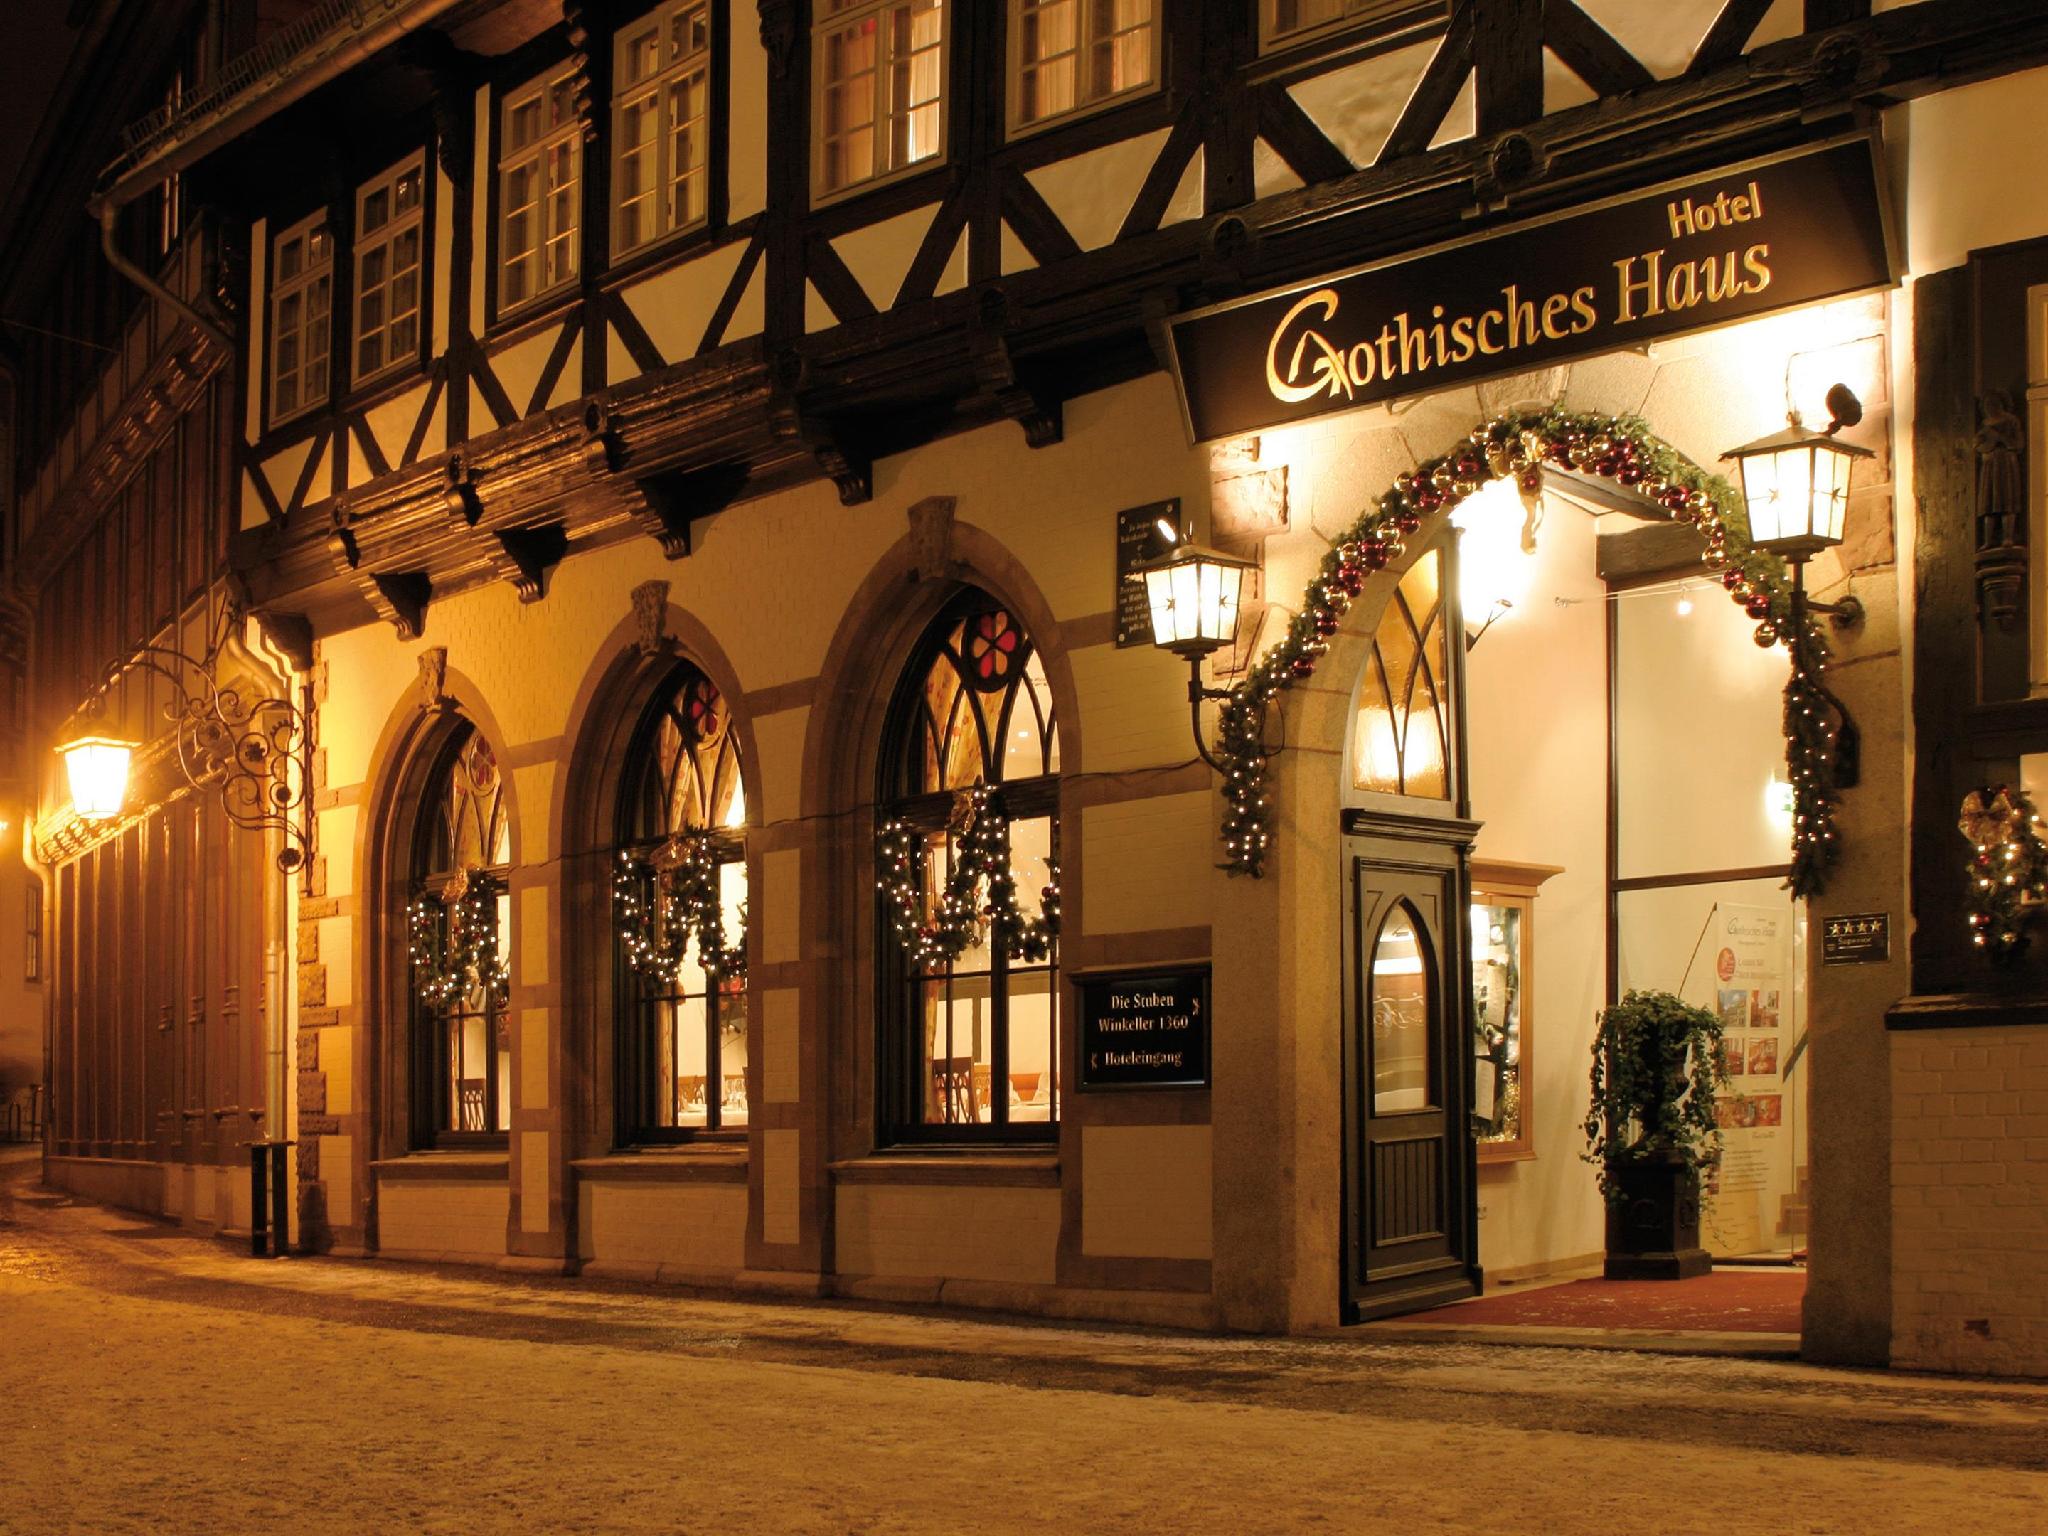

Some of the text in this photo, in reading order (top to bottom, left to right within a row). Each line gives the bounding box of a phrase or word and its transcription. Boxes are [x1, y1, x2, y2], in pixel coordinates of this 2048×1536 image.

[1667, 181, 1763, 238] Hotel
[1266, 244, 1771, 403] Gothisches Haus
[1111, 992, 1174, 1009] Die Stuben
[1160, 1015, 1189, 1030] 1360
[1105, 1050, 1182, 1067] Hoteleingang
